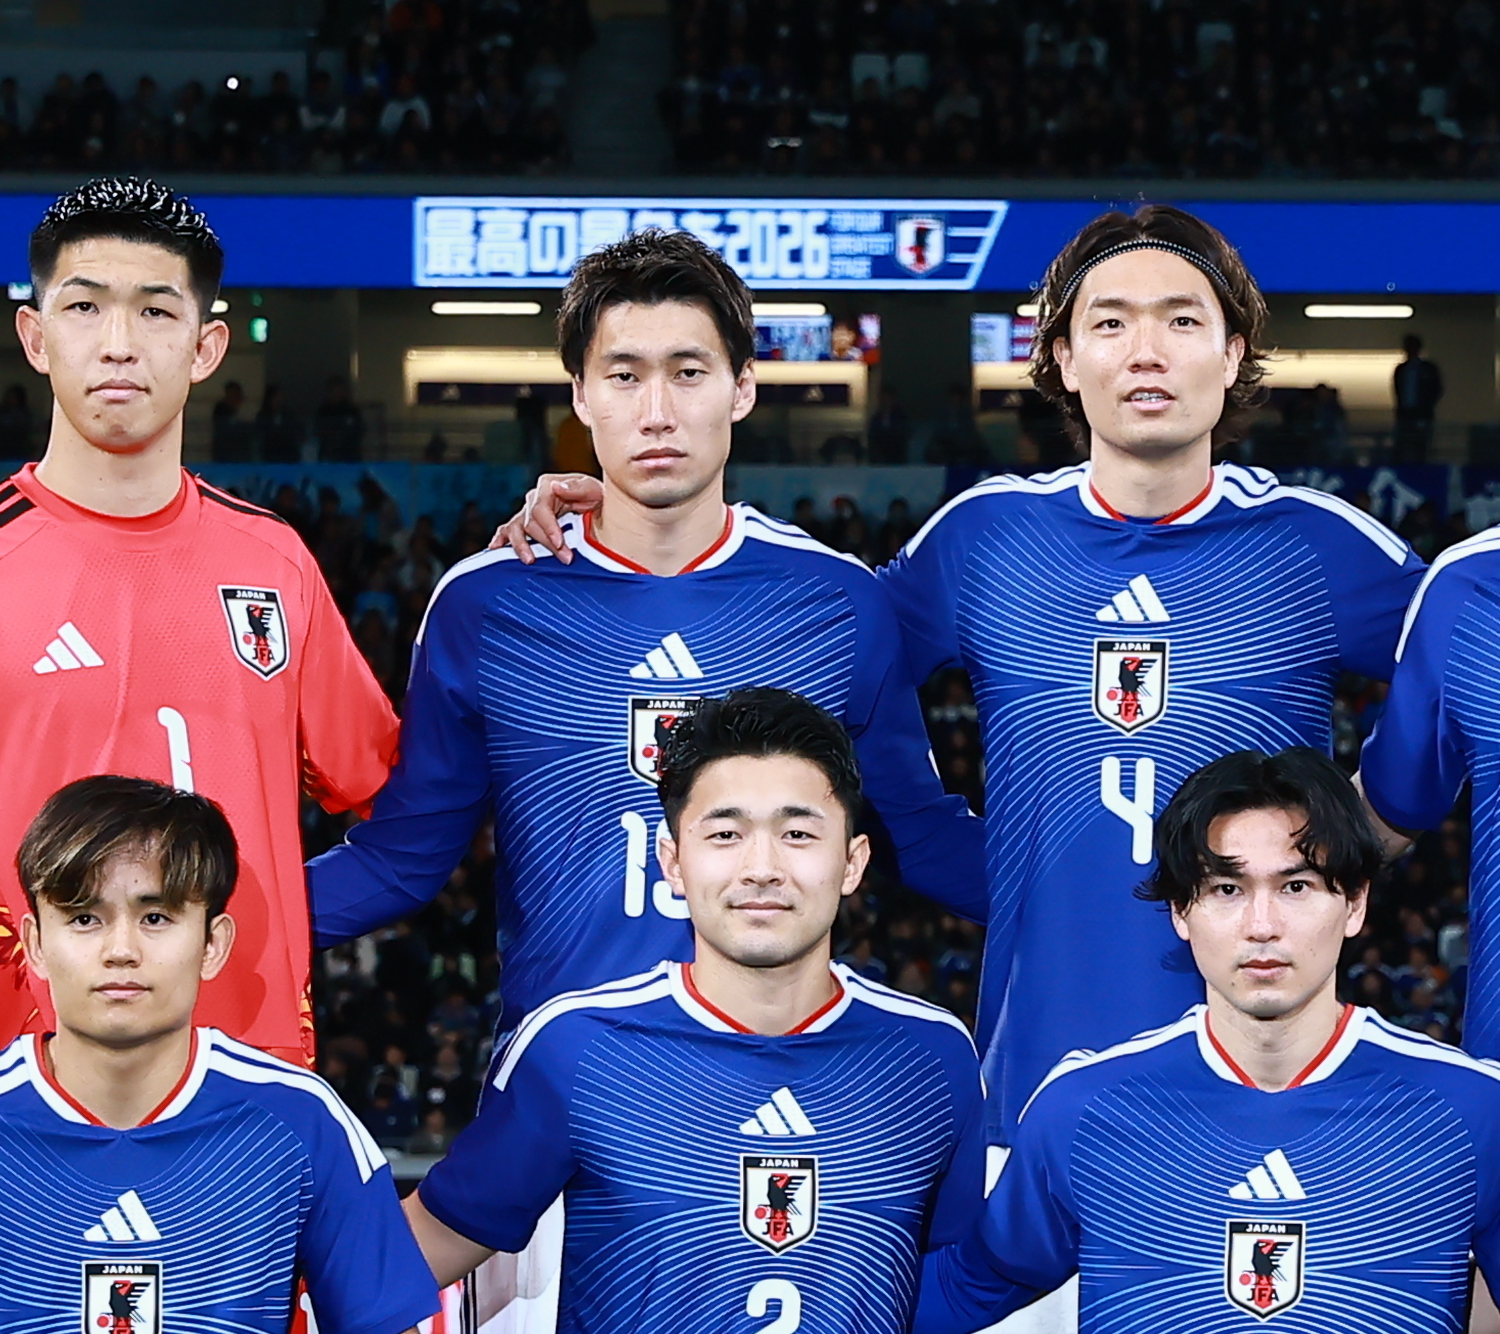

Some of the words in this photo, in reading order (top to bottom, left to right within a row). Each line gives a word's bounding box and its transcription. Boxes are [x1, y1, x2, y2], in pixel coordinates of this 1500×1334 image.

[236, 590, 266, 601] JAPAN
[1113, 643, 1151, 652] JAPAN
[647, 701, 685, 709] JAPAN
[157, 706, 195, 796] 1
[1100, 756, 1155, 864] 4
[760, 1159, 799, 1168] JAPAN
[762, 1221, 794, 1236] JFA
[1246, 1224, 1286, 1234] JAPAN
[102, 1265, 143, 1274] JAPAN
[1247, 1288, 1279, 1302] JFA
